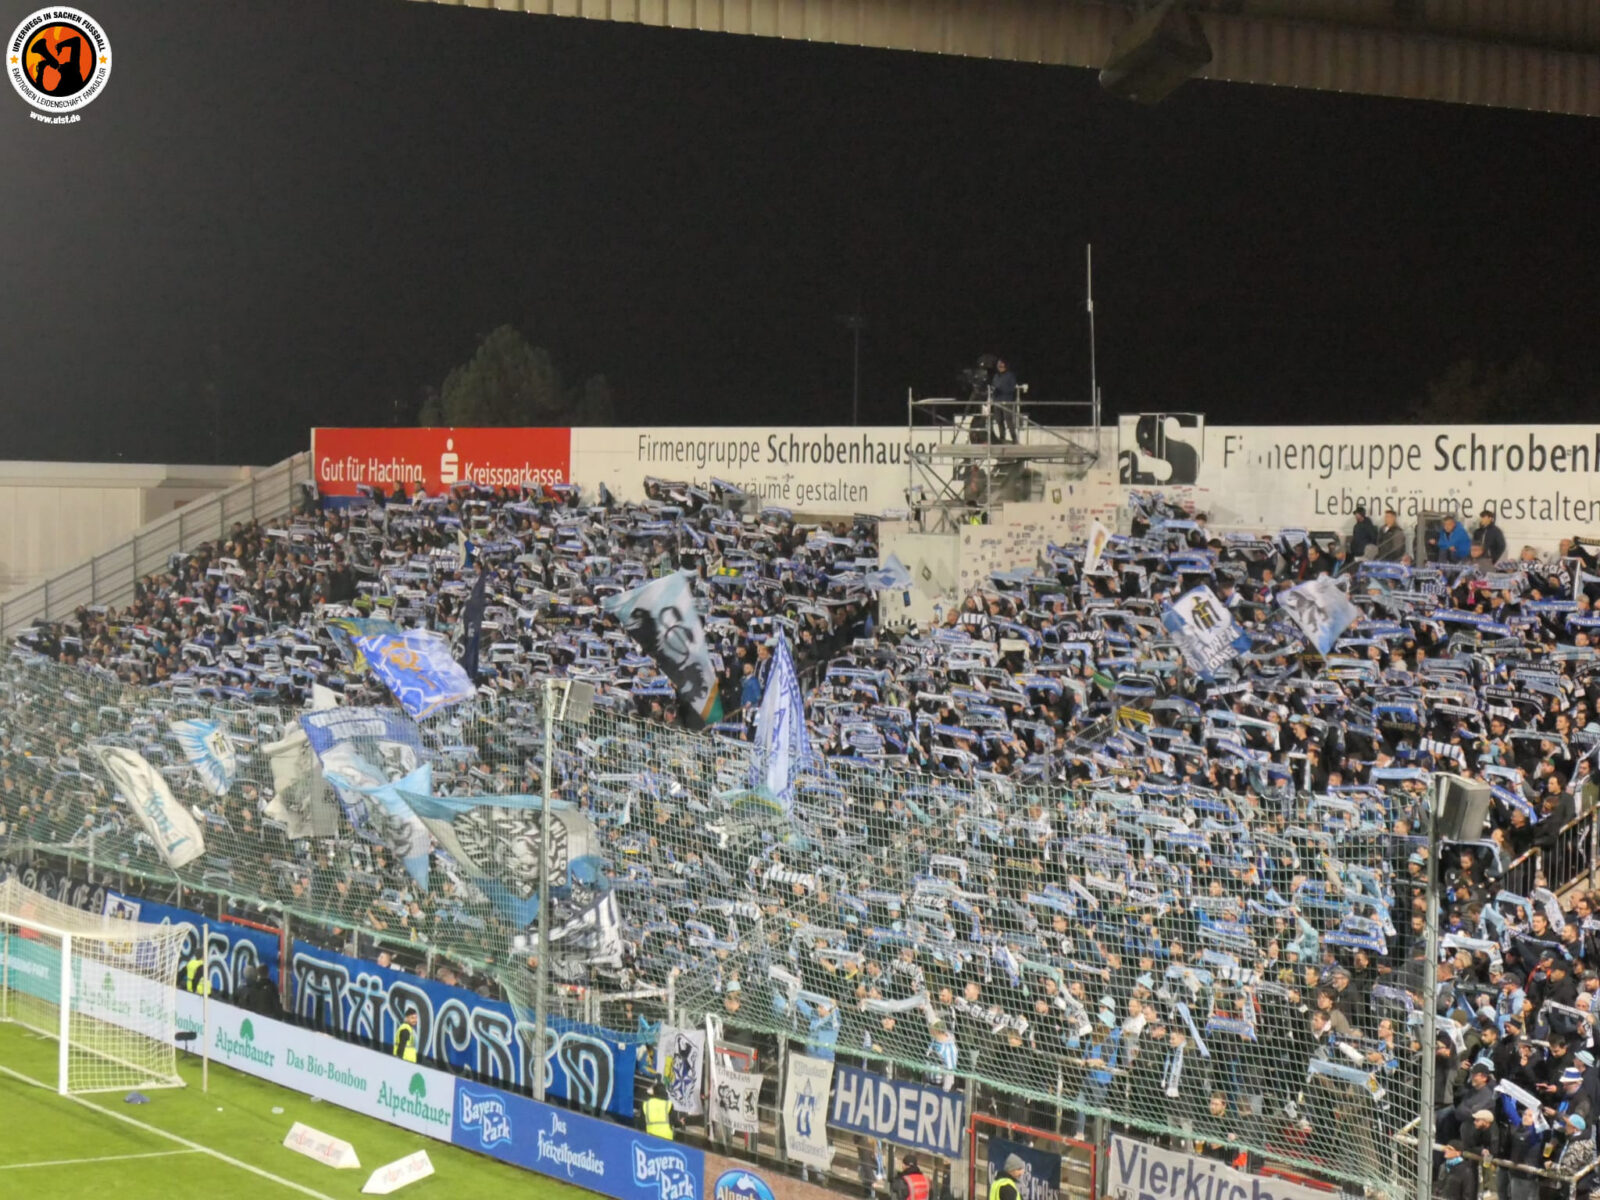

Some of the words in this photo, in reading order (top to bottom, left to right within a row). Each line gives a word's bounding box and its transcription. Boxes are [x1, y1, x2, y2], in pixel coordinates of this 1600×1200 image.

[637, 434, 761, 469] Firmengruppe
[767, 432, 937, 465] Schrobenhauser
[321, 457, 344, 482] Gut
[347, 456, 366, 482] für
[368, 457, 426, 483] Haching.
[464, 462, 562, 486] Kreissparkasse
[796, 480, 868, 506] gestalten
[1484, 491, 1600, 523] gestalten
[214, 1026, 276, 1068] Alpenbauer
[286, 1048, 305, 1070] Das
[307, 1057, 368, 1092] Bio-Bonbon
[377, 1080, 452, 1127] Alpenbauer
[462, 1096, 504, 1126] Bayern
[549, 1112, 567, 1137] Das
[832, 1070, 962, 1154] HADERN
[482, 1116, 511, 1143] Park
[635, 1146, 685, 1181] Bayern
[660, 1170, 694, 1200] Park
